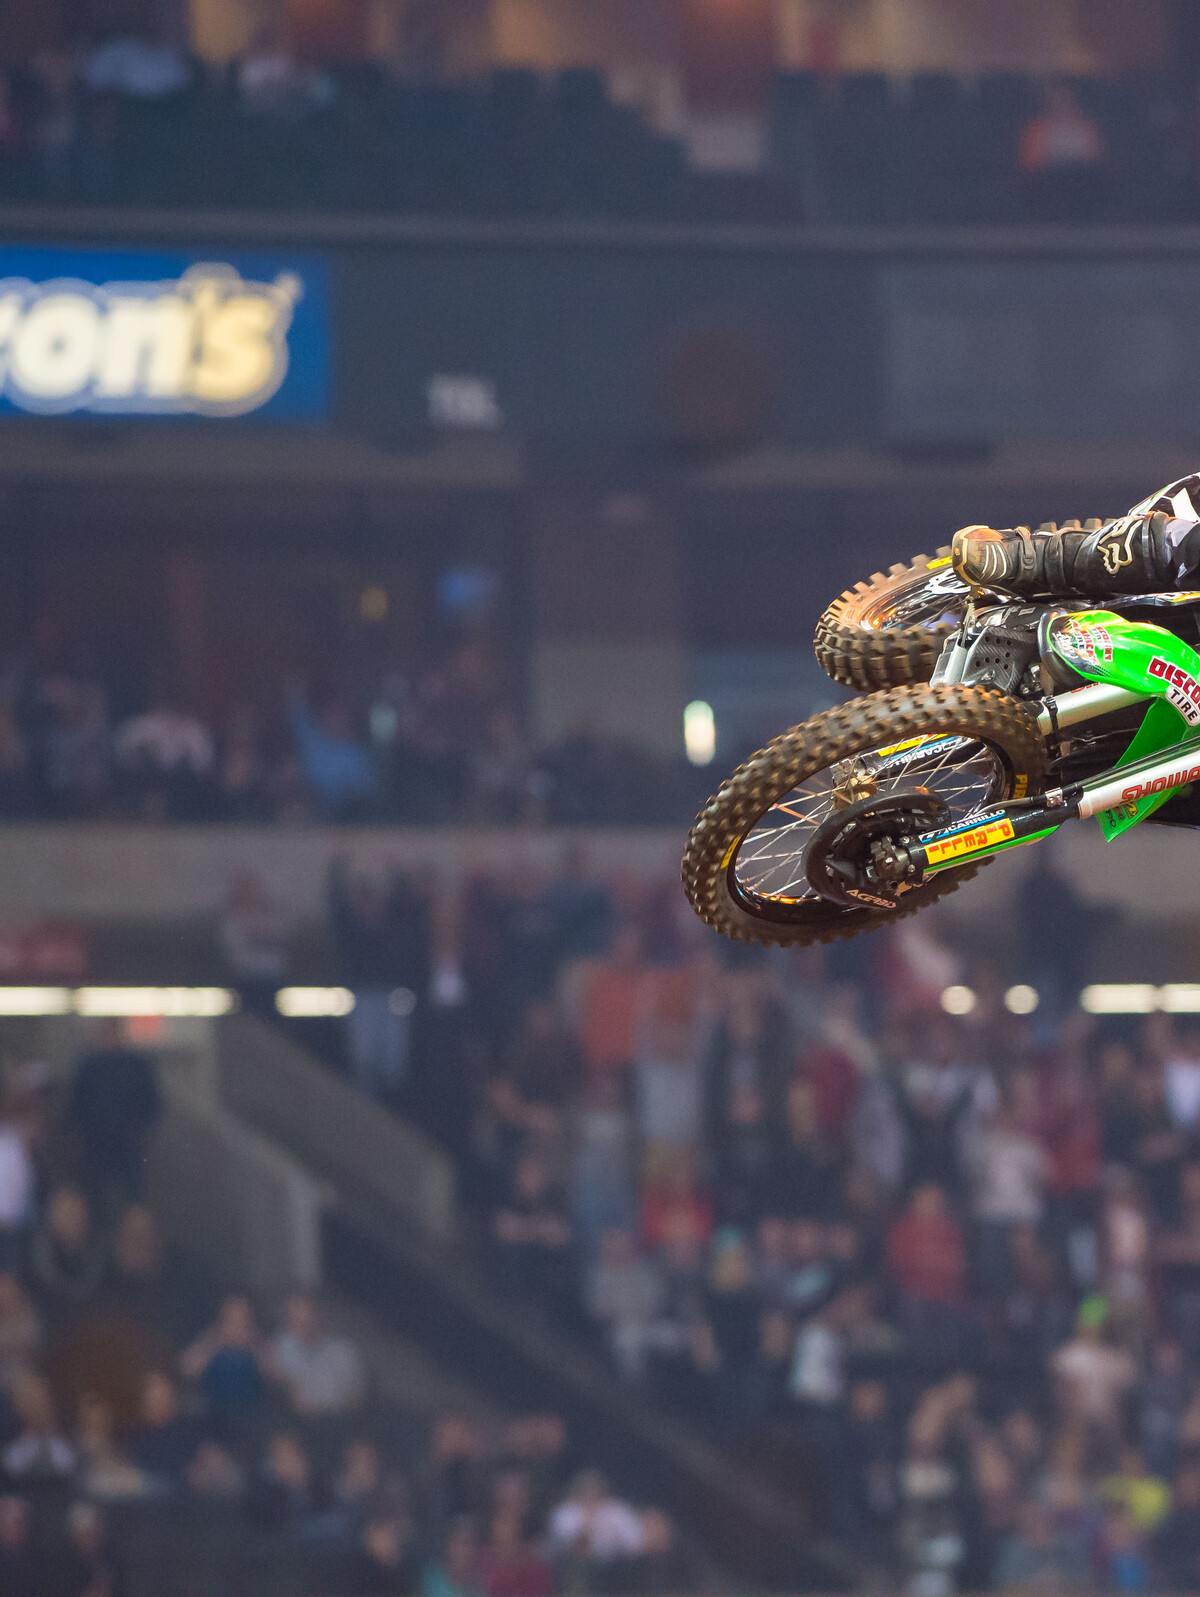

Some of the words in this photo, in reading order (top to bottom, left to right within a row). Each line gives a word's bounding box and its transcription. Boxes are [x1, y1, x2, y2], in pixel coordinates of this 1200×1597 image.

[1170, 688, 1198, 721] TIRE
[948, 809, 1006, 831] CARRILLO
[927, 822, 1012, 855] PIRELLI
